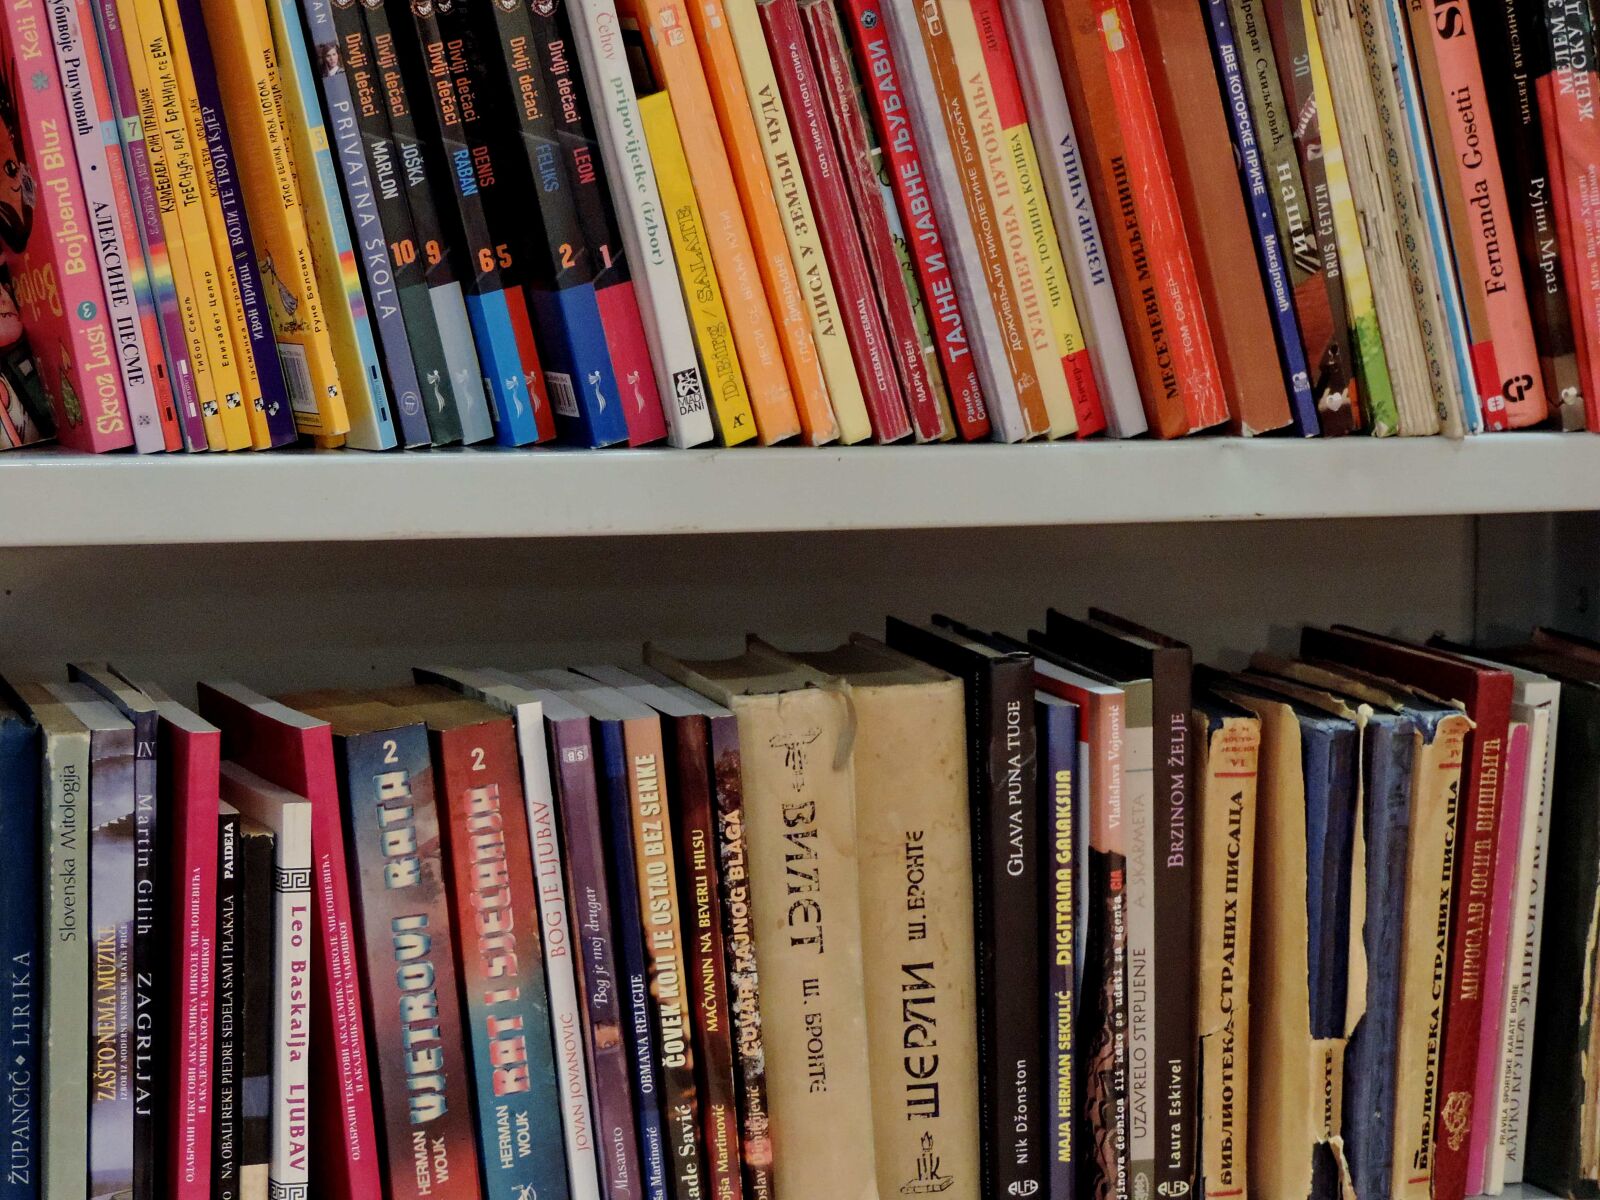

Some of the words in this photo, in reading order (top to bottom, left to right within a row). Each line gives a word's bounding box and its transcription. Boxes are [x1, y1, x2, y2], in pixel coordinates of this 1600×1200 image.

[20, 15, 42, 60] Keli
[345, 32, 368, 69] Divlji
[596, 12, 618, 59] Čehov
[788, 42, 805, 81] СПИРА
[1220, 44, 1238, 71] ДВЕ
[1549, 16, 1576, 95] МЕЛЕМ
[64, 57, 93, 135] Ршумовић
[352, 71, 380, 118] dečaci
[799, 83, 812, 107] ПОП
[867, 40, 913, 152] ЉУБАВИ
[1564, 26, 1595, 121] ЖЕНСКУ
[201, 106, 221, 142] КЛЕР
[757, 84, 783, 146] ЧУДА
[809, 119, 824, 151] ЋИРА
[968, 71, 1010, 199] ПУТОВАЊА
[1227, 74, 1254, 146] КОТОРСКЕ
[1451, 86, 1484, 168] Gosetti
[40, 118, 65, 171] Bluz
[213, 145, 233, 185] ТВОЈА
[371, 139, 399, 201] MARLON
[401, 142, 425, 187] JOŠKA
[472, 145, 495, 188] DENIS
[535, 143, 560, 193] FELIKS
[573, 146, 597, 184] LEON
[610, 76, 650, 193] pripovijetke
[637, 202, 665, 266] (izbor)
[818, 153, 830, 178] ПОП
[1010, 133, 1035, 194] КОЛИБА
[221, 189, 237, 206] ТЕ
[453, 148, 479, 197] RABAN
[775, 151, 809, 236] ЗЕМЉИ
[1243, 149, 1265, 197] ПРИЧЕ
[46, 178, 88, 276] Bojbend
[225, 210, 245, 247] ВОЛИ
[333, 100, 376, 228] PRIVATNA
[366, 238, 397, 319] ŠKOLA
[901, 160, 938, 244] ЈАВНЕ
[970, 167, 1006, 258] НИКОЛЕТИНЕ
[1060, 133, 1105, 287] ИЗБИРАЧИЦА
[1110, 155, 1151, 281] МИЉЕНИЦИ
[1315, 184, 1335, 235] ČETVIN
[425, 240, 442, 265] 9
[497, 244, 513, 268] 5
[558, 243, 576, 269] 2
[676, 205, 714, 304] SALATE
[799, 246, 814, 258] У
[1026, 198, 1052, 264] ТОМИНА
[1470, 179, 1508, 296] Fernanda
[239, 262, 259, 304] ПРИНЦ
[297, 249, 318, 301] Белсвик
[478, 247, 495, 273] 6
[925, 252, 946, 273] И
[1002, 206, 1048, 351] ГУЛИВЕРОВА
[1323, 243, 1340, 278] BRUS
[93, 201, 130, 307] АЛЕКСИНЕ
[122, 316, 145, 387] ПЕСМЕ
[184, 296, 198, 333] Секељ
[203, 270, 220, 307] Целер
[807, 264, 836, 337] АЛИСА
[80, 322, 110, 371] Lusi
[212, 312, 230, 367] Елизабет
[249, 309, 265, 340] ИВОН
[310, 310, 323, 333] Руне
[932, 277, 970, 362] ТАЈНЕ
[1142, 287, 1179, 400] МЕСЕЧЕВИ
[193, 338, 206, 374] Тибор
[870, 347, 887, 392] СТЕВАН
[904, 340, 919, 369] ТВЕН
[96, 372, 125, 434] Skroz
[913, 371, 927, 402] МАРК
[962, 389, 976, 424] Ранко
[969, 371, 986, 421] Симовић
[383, 740, 398, 764] 2
[1006, 700, 1022, 750] TUGE
[1106, 705, 1122, 761] Vojnović
[1167, 713, 1188, 767] ŽELJE
[59, 764, 82, 850] Mitologija
[635, 753, 661, 816] SENKE
[1007, 754, 1023, 806] PUNA
[1108, 764, 1122, 829] Vladislava
[1475, 737, 1501, 832] ВИШЊИЋ
[137, 794, 154, 868] Martin
[372, 771, 422, 889] RATA
[531, 800, 560, 876] LJUBAV
[641, 820, 666, 857] BEZ
[1007, 810, 1024, 876] GLAVA
[1056, 770, 1072, 864] GALAKSIJA
[1130, 793, 1147, 887] SKARMETA
[1167, 774, 1185, 868] BRZINOM
[1225, 790, 1244, 893] ПИСАЦА
[223, 822, 234, 879] PAIDEIA
[692, 829, 707, 870] HILSU
[723, 809, 745, 880] BLAGA
[905, 830, 926, 911] БРОНТЕ
[1469, 838, 1492, 897] ЈОСИЋ
[59, 858, 76, 942] Slovenska
[136, 879, 154, 934] Gilih
[190, 867, 202, 947] МИЛОШЕВИЋА
[543, 883, 564, 902] JE
[645, 861, 673, 925] OSTAO
[695, 876, 711, 928] BEVERLI
[1110, 870, 1124, 890] CIA
[222, 895, 234, 951] PLAKALA
[291, 905, 308, 948] Leo
[545, 911, 567, 958] BOG
[584, 886, 604, 932] drugar
[1056, 868, 1072, 966] DIGITALNA
[1111, 895, 1125, 941] agenta
[97, 925, 117, 991] MUZIKE
[588, 936, 606, 961] moj
[651, 929, 676, 950] JE
[699, 932, 713, 953] NA
[1112, 946, 1123, 962] za
[1219, 898, 1238, 1014] СТРАНИХ
[1460, 902, 1486, 1001] МИРОСЛАВ
[12, 951, 31, 1047] LIRIKA
[189, 951, 200, 994] НИКОЛЕ
[222, 962, 234, 989] SAM
[654, 955, 680, 999] KOJI
[701, 958, 719, 1032] MAČVANIN
[1109, 968, 1124, 1007] udati
[1131, 947, 1147, 1042] STRPLJENJE
[1508, 984, 1519, 1014] BORBE
[97, 994, 117, 1044] NEMA
[187, 997, 199, 1063] АКАДЕМИКА
[222, 991, 234, 1038] SEDELA
[286, 960, 308, 1062] Baskalja
[391, 912, 449, 1124] VJETROVI
[631, 974, 647, 1033] RELIGIJE
[1054, 990, 1072, 1050] SEKULIĆ
[1113, 1012, 1124, 1027] se
[136, 972, 152, 1116] ZAGRLJAJ
[485, 1015, 531, 1097] RAT
[559, 1011, 585, 1099] JOVANOVIĆ
[660, 1002, 687, 1068] ČOVEK
[901, 961, 940, 1121] ШЕРЛИ
[1110, 1034, 1124, 1064] kako
[1506, 1018, 1516, 1053] KARATE
[93, 1047, 117, 1101] ZAŠTO
[222, 1041, 235, 1084] PJEDRE
[637, 1037, 654, 1093] OBMANA
[1058, 1054, 1072, 1118] HERMAN
[1109, 1069, 1124, 1091] ili
[1167, 1059, 1182, 1117] Eskivel
[1502, 1058, 1513, 1104] SPORTSKE
[186, 1068, 197, 1124] ТЕКСТОВИ
[221, 1087, 233, 1119] REKE
[1013, 1059, 1029, 1132] Džonston
[1132, 1047, 1148, 1139] UZAVRELO
[1219, 1022, 1235, 1185] БИБЛИОТЕКА
[8, 1071, 30, 1184] ŽUPANČIČ
[221, 1122, 233, 1159] OBALI
[495, 1105, 514, 1169] HERMAN
[515, 1111, 532, 1157] WOUK
[571, 1104, 591, 1151] JOVAN
[674, 1104, 696, 1155] Savić
[711, 1104, 731, 1173] Martinović
[1014, 1138, 1029, 1165] Nik
[1058, 1120, 1072, 1162] MAJA
[1110, 1099, 1126, 1151] desnica
[1168, 1122, 1182, 1169] Laura
[1499, 1109, 1508, 1146] PRAVILA
[185, 1127, 197, 1182] ОДАБРАНИ
[221, 1161, 233, 1179] NA
[412, 1130, 432, 1195] HERMAN
[432, 1136, 449, 1184] WOUK
[611, 1126, 631, 1196] Masaroto
[645, 1126, 664, 1187] Martinović
